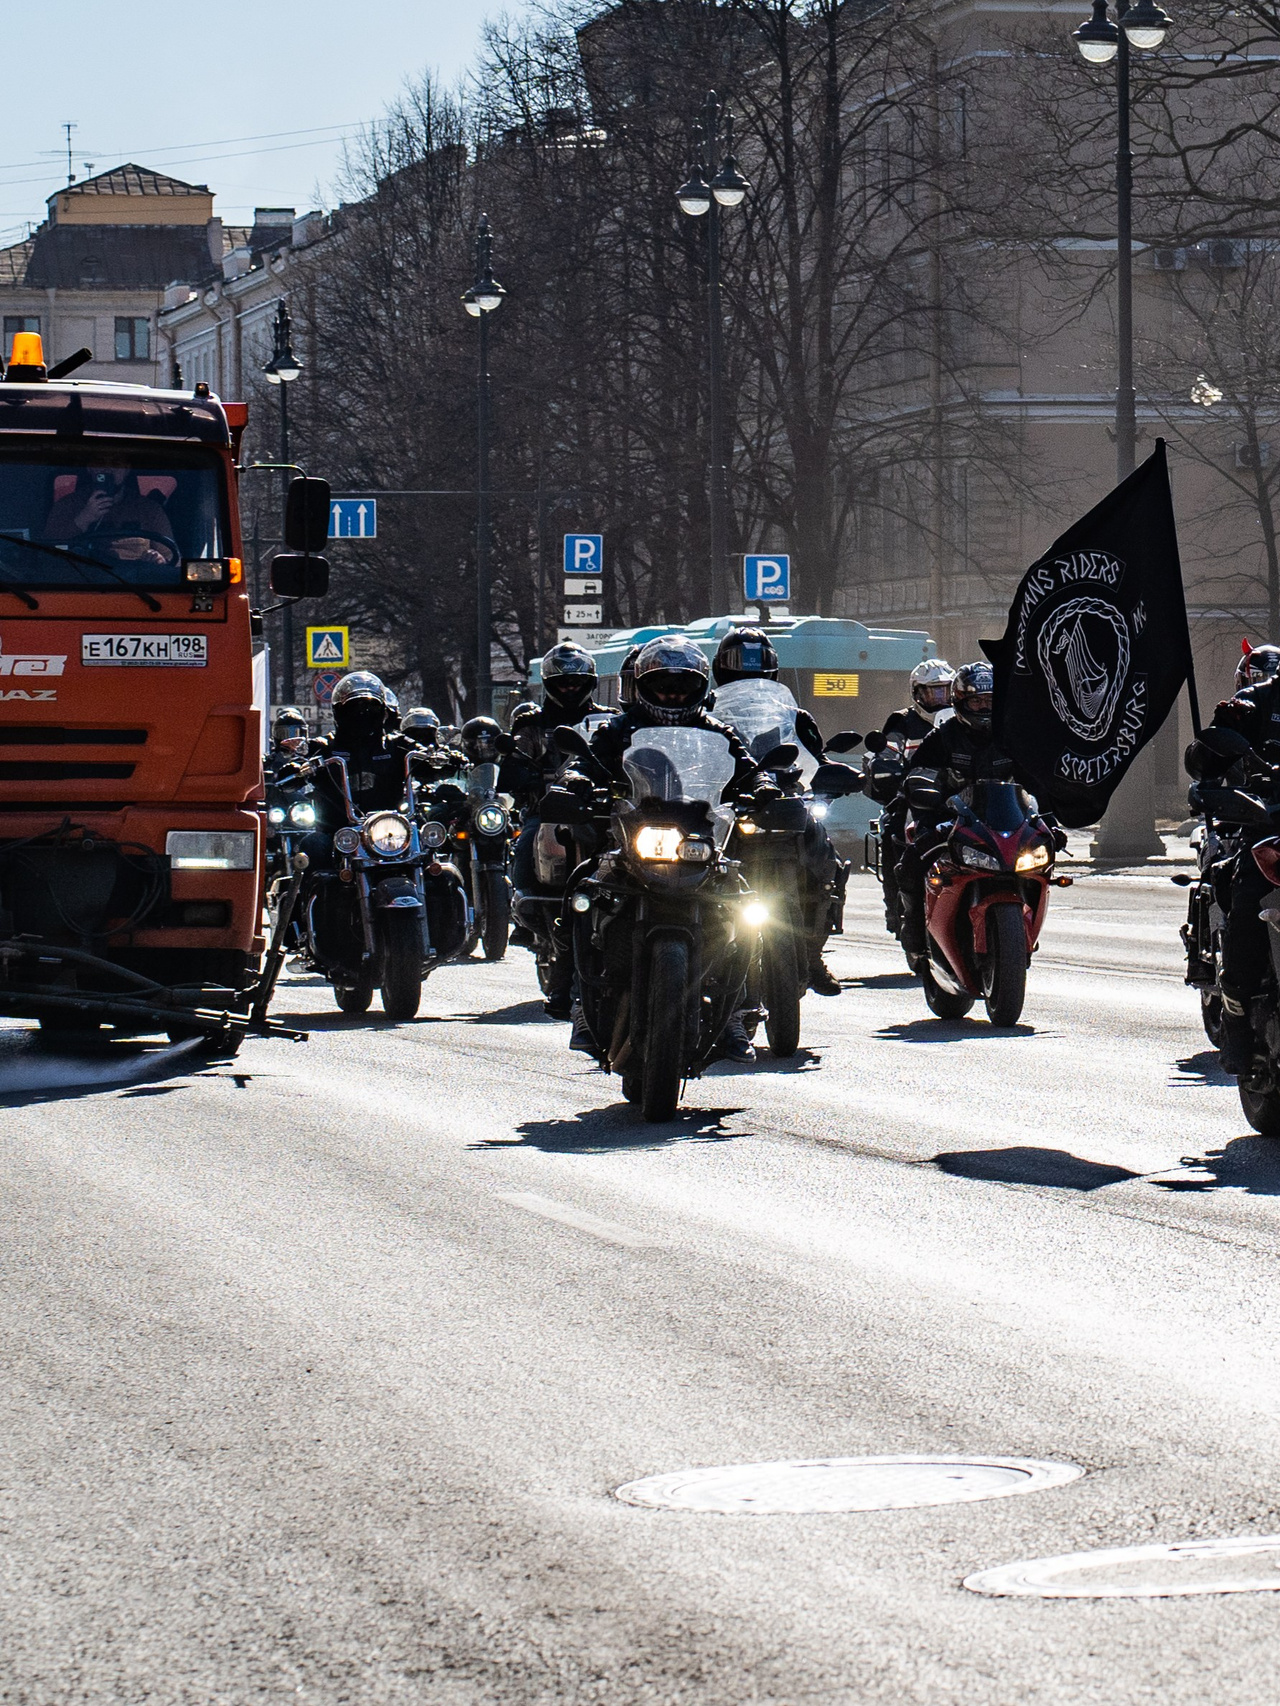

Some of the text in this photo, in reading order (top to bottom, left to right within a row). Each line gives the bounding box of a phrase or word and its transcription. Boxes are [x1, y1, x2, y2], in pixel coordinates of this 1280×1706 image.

[574, 539, 596, 569] P
[756, 560, 782, 596] P
[1016, 552, 1120, 669] NORMANS RIDERS
[172, 637, 202, 652] 198
[826, 678, 846, 692] 50
